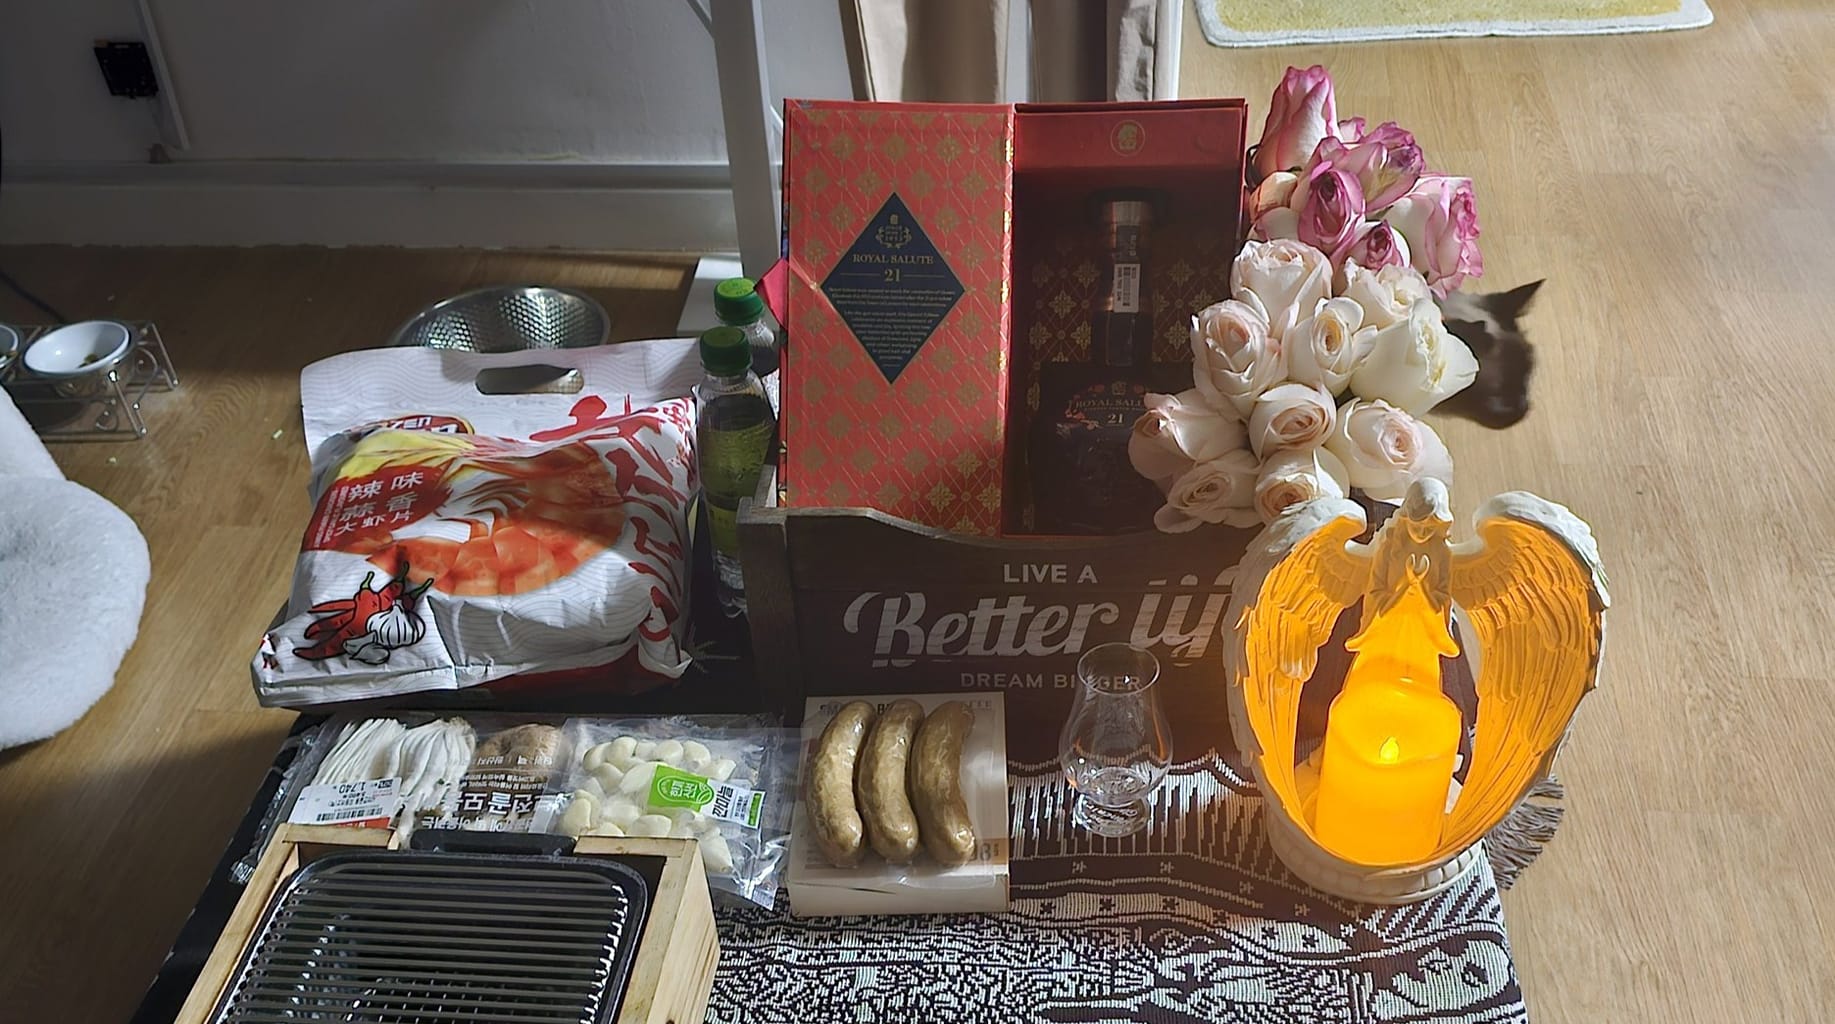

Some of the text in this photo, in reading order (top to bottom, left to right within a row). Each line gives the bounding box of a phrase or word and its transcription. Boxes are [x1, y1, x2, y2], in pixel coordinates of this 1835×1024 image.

[852, 254, 934, 265] ROYAL SALUTE
[884, 268, 900, 282] 21
[1107, 413, 1124, 424] 21
[1003, 563, 1098, 584] LIVE A
[843, 591, 1119, 668] Better
[960, 673, 1044, 689] DREAM
[339, 782, 365, 794] 1,740
[711, 785, 734, 818] 깐마늘
